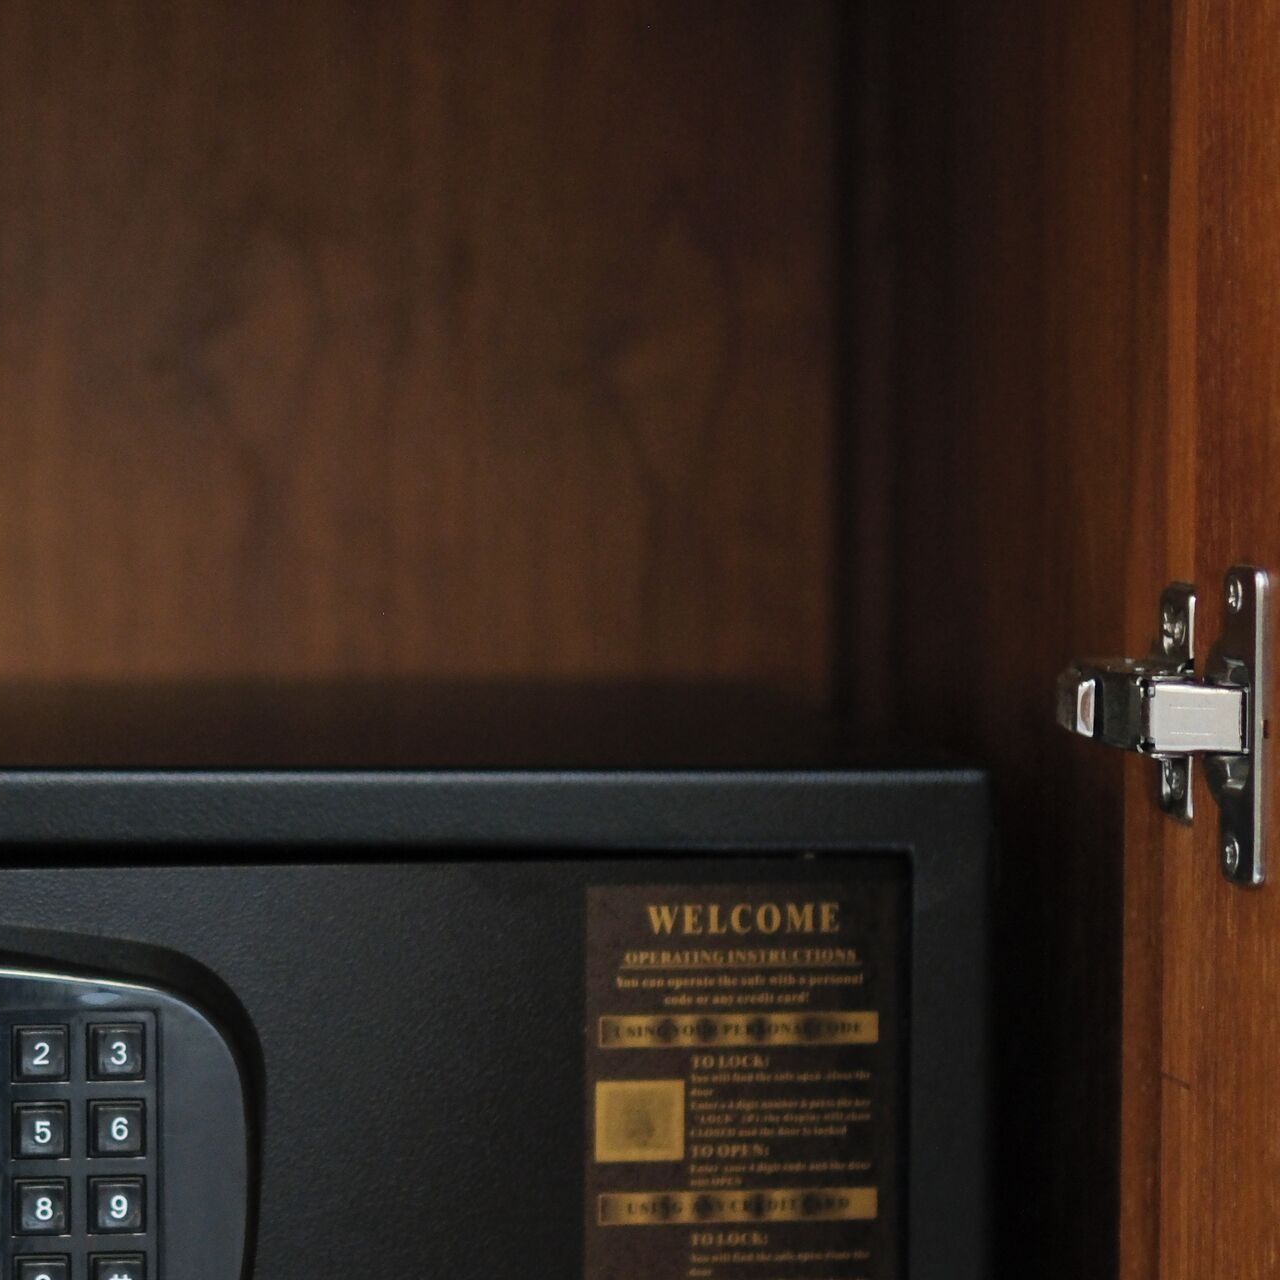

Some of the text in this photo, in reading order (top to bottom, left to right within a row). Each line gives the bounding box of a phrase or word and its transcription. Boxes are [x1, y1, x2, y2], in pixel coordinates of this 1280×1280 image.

[646, 901, 841, 936] WELCOME
[624, 948, 857, 965] OPERATING INSTRUCTIONS
[32, 1042, 50, 1066] 2
[110, 1041, 128, 1066] 3
[34, 1120, 52, 1144] 5
[111, 1117, 129, 1141] 6
[35, 1197, 53, 1221] 8
[110, 1195, 128, 1219] 9
